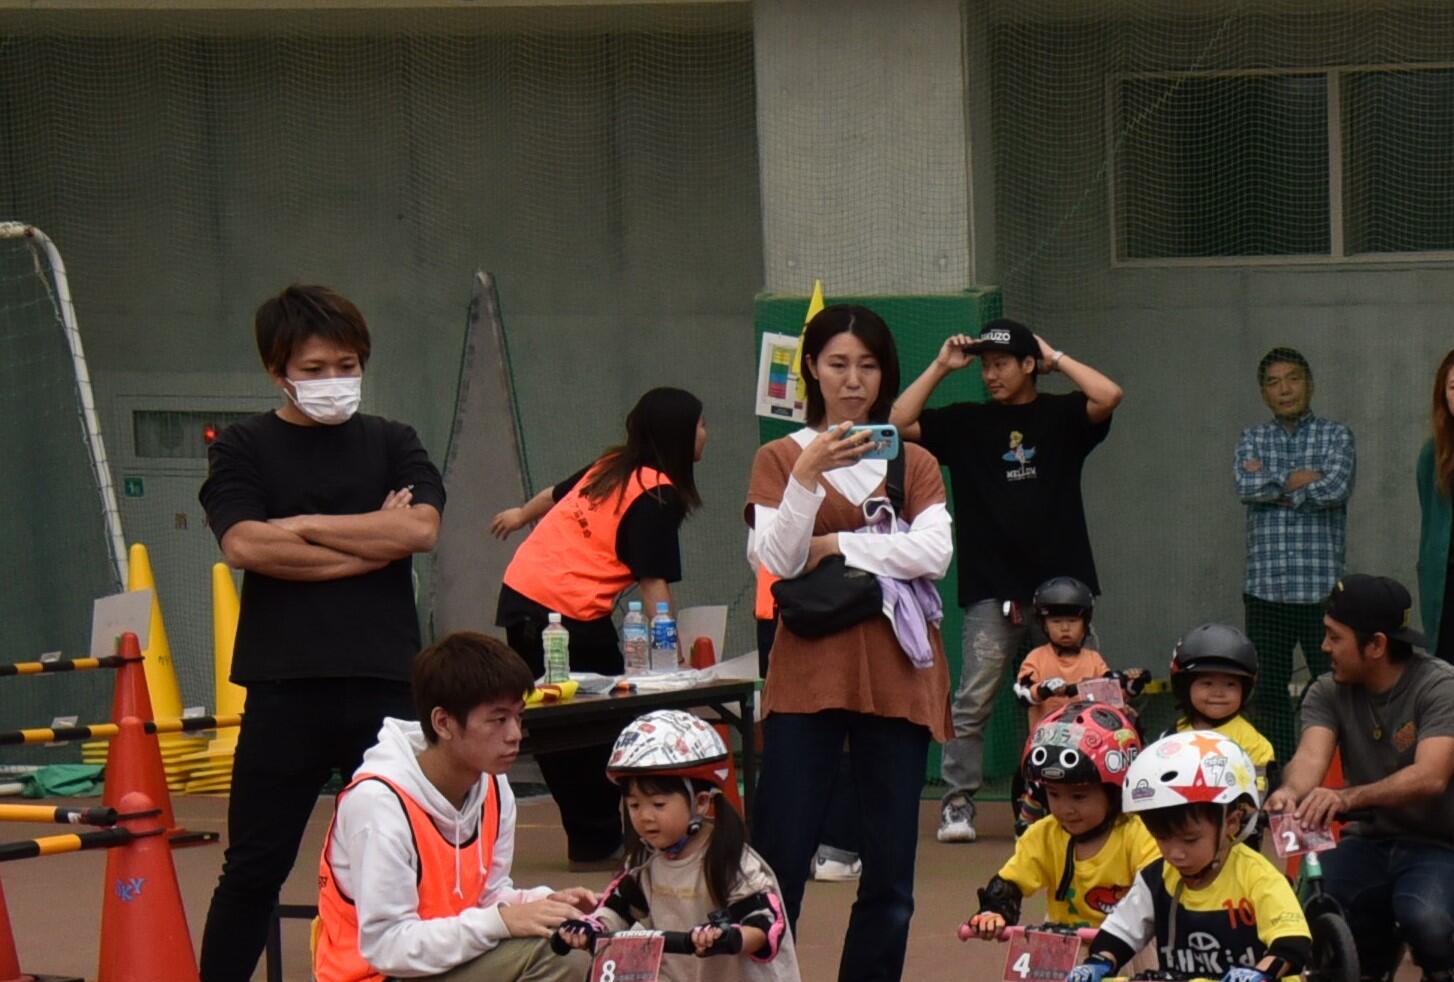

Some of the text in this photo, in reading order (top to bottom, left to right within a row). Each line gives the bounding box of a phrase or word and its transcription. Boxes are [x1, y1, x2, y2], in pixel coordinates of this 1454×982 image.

[1282, 831, 1300, 853] 2
[1222, 897, 1256, 929] 10
[1012, 952, 1031, 979] 4
